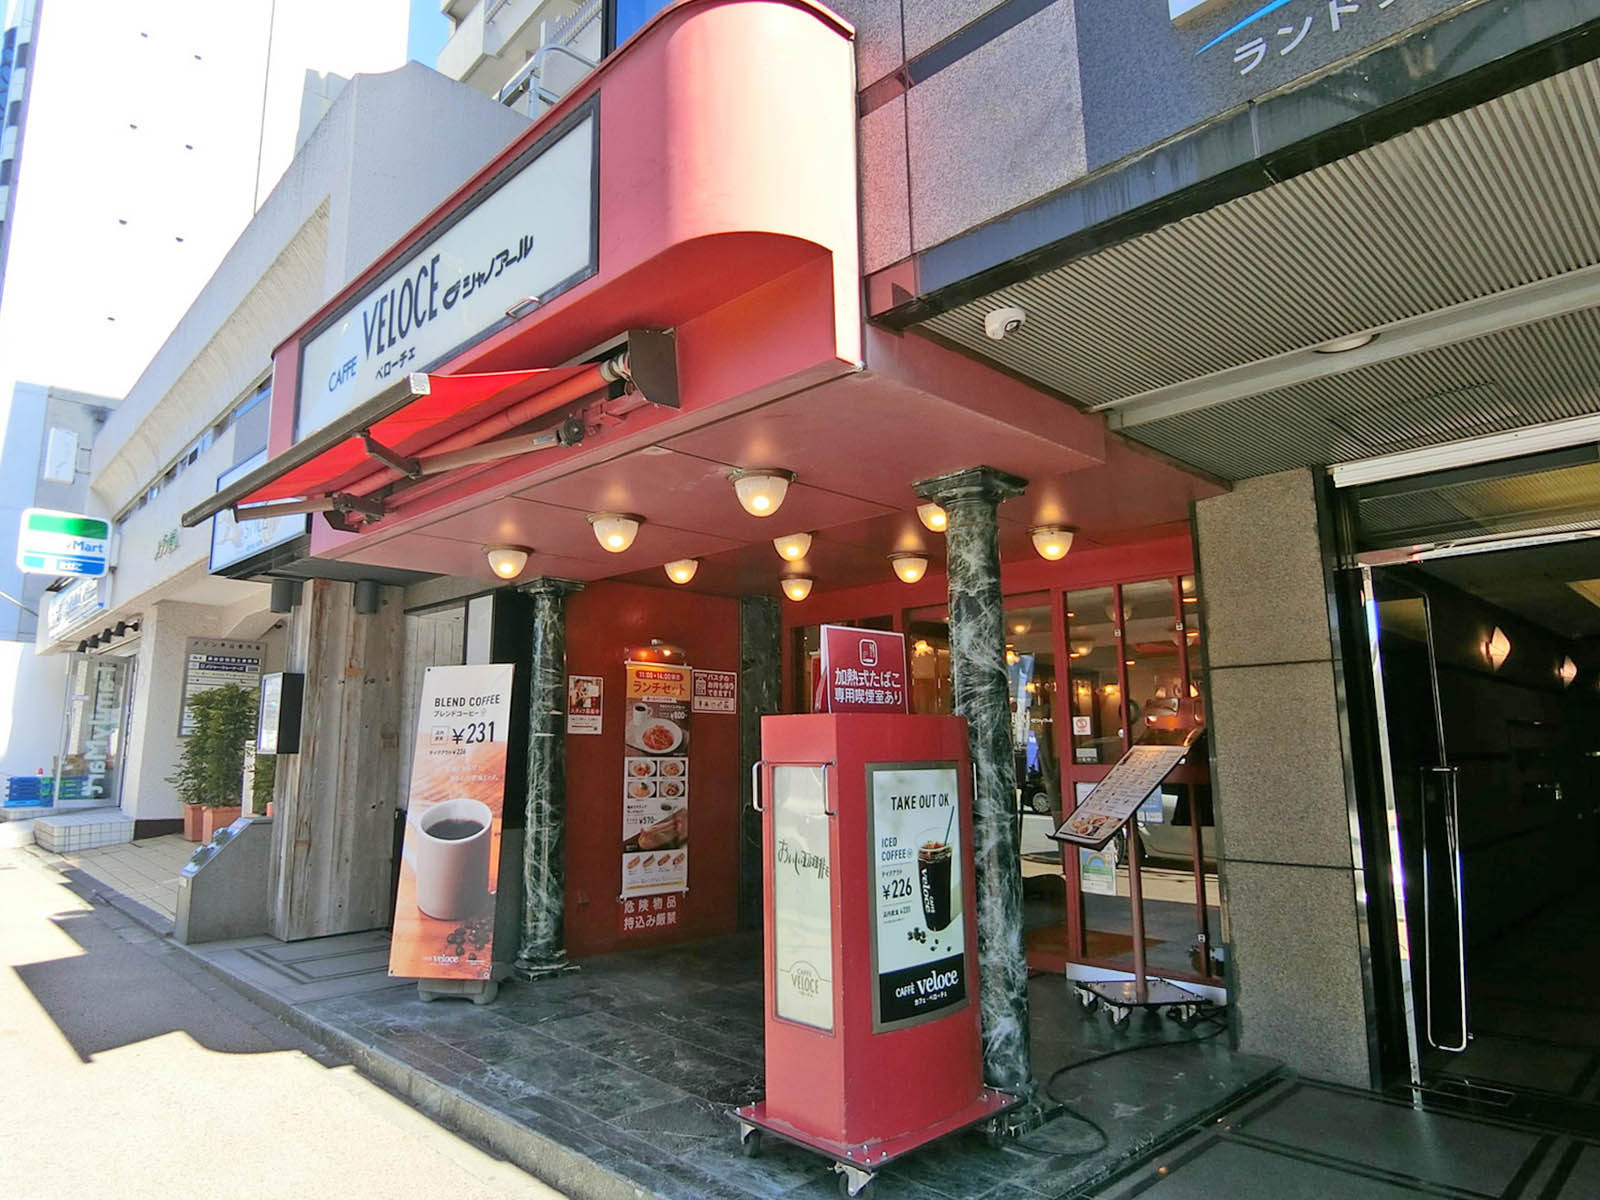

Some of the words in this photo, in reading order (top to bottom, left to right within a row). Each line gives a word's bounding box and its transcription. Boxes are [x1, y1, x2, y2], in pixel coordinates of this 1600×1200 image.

[463, 235, 535, 299] シャノアール
[363, 255, 441, 361] VELOCE
[376, 348, 416, 380] ベローチェ
[633, 680, 686, 696] ランチセット
[835, 668, 902, 688] 加熱式たばこ
[435, 698, 466, 708] BLEND
[469, 695, 502, 707] COFFEE
[835, 688, 903, 705] 専用喫煙室あり
[434, 710, 480, 718] ブレンドコーヒー
[452, 721, 496, 745] ¥231
[891, 796, 917, 811] TAKE
[919, 794, 938, 809] OUT
[939, 793, 950, 807] OK
[882, 837, 898, 848] ICED
[882, 849, 907, 862] COFFEE
[882, 877, 913, 901] ¥226
[920, 868, 932, 913] veloce
[624, 913, 678, 931] 持込み厳禁
[791, 974, 820, 995] VELOCE
[917, 970, 960, 995] veloce
